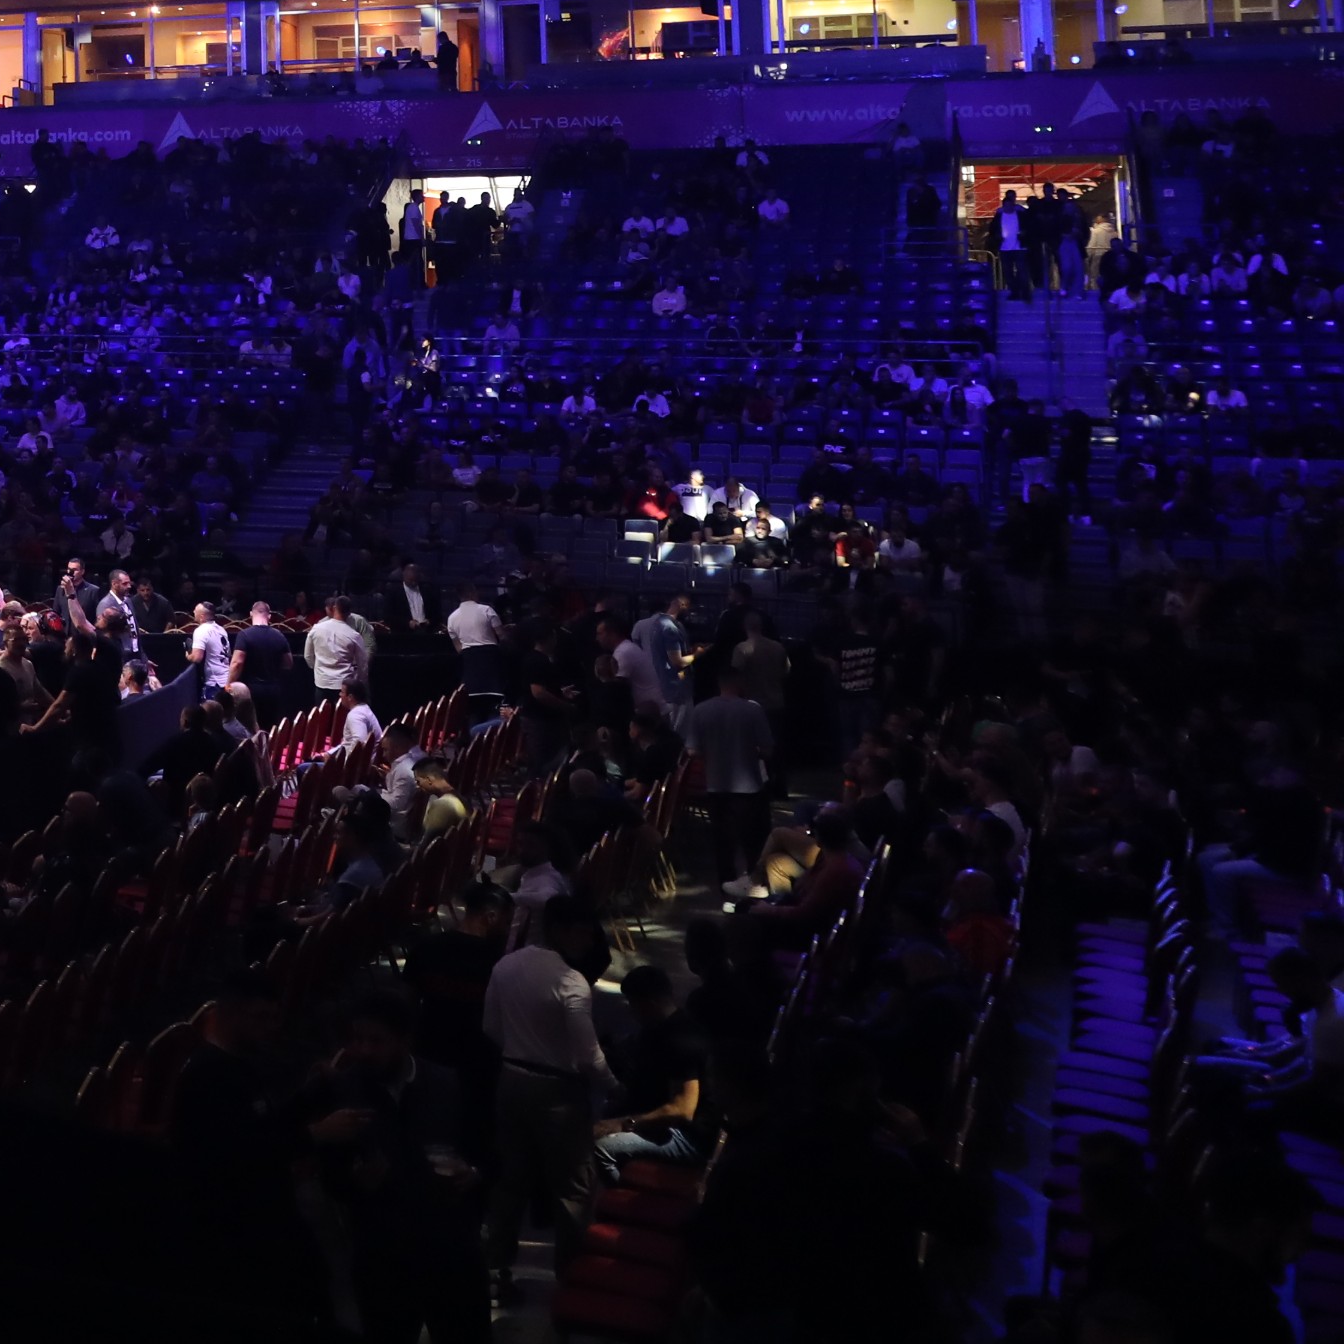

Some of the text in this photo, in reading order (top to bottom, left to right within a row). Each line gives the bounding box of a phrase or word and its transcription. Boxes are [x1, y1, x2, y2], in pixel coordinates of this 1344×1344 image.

[1125, 96, 1271, 113] ALTABANKA
[506, 115, 624, 132] ALTABANKA
[466, 159, 482, 168] 215
